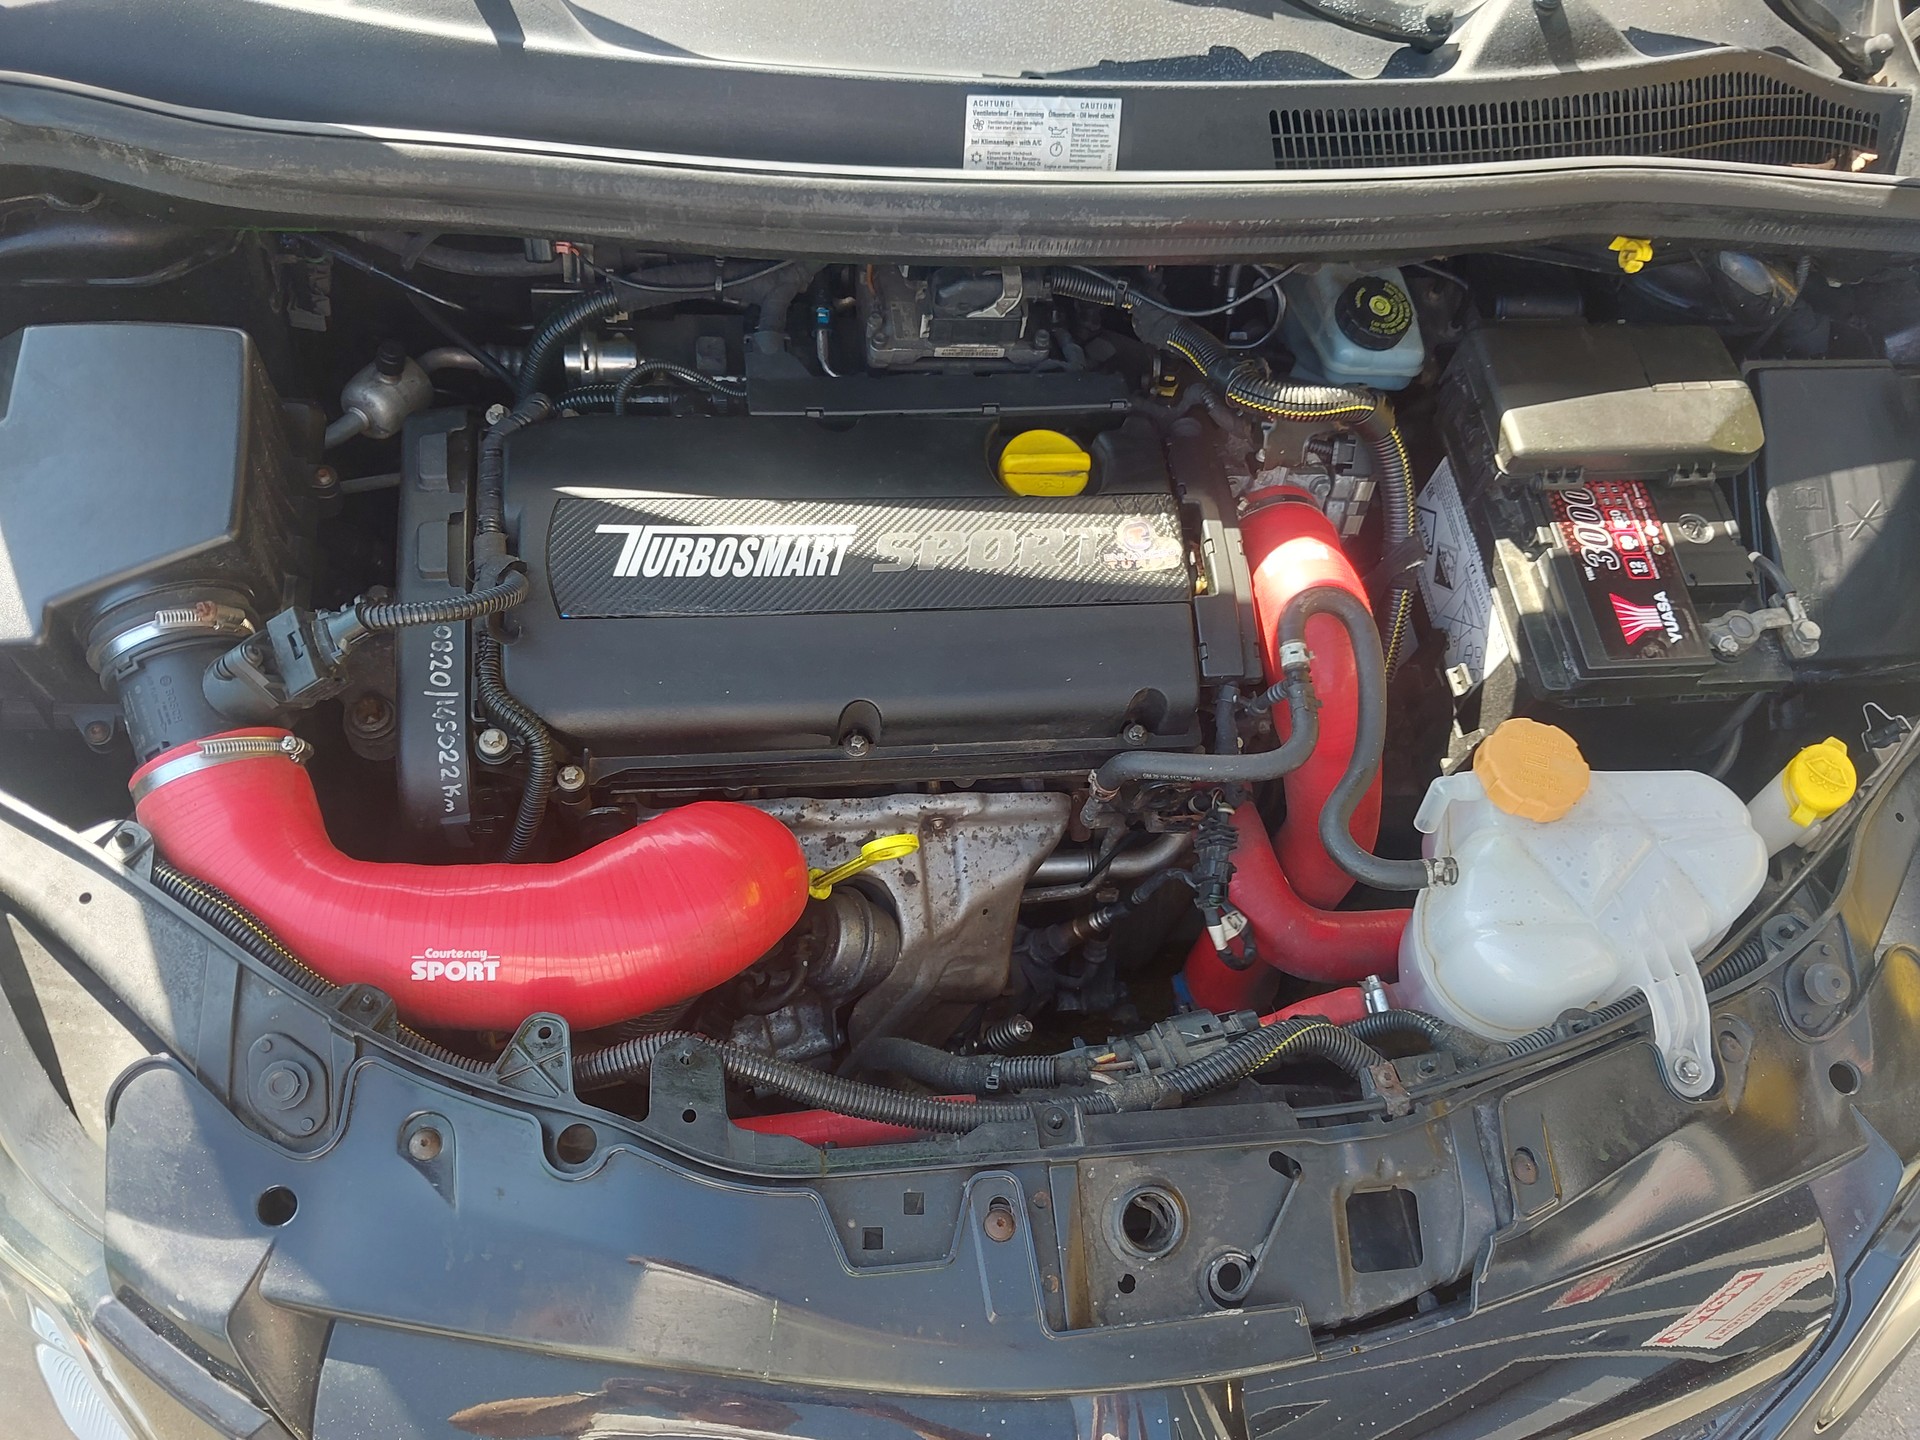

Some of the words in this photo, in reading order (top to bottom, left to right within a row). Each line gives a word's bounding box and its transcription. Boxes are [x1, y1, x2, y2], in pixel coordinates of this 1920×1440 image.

[973, 100, 1013, 108] ACHTUNG!
[1080, 102, 1116, 110] CAUTION!
[1559, 487, 1620, 571] 3000
[595, 524, 858, 578] TURBOSMART
[872, 526, 1112, 573] SPORT
[1629, 561, 1643, 575] 12
[1653, 590, 1684, 645] YUASA
[425, 948, 488, 962] Courtenay
[411, 961, 501, 982] SPORT
